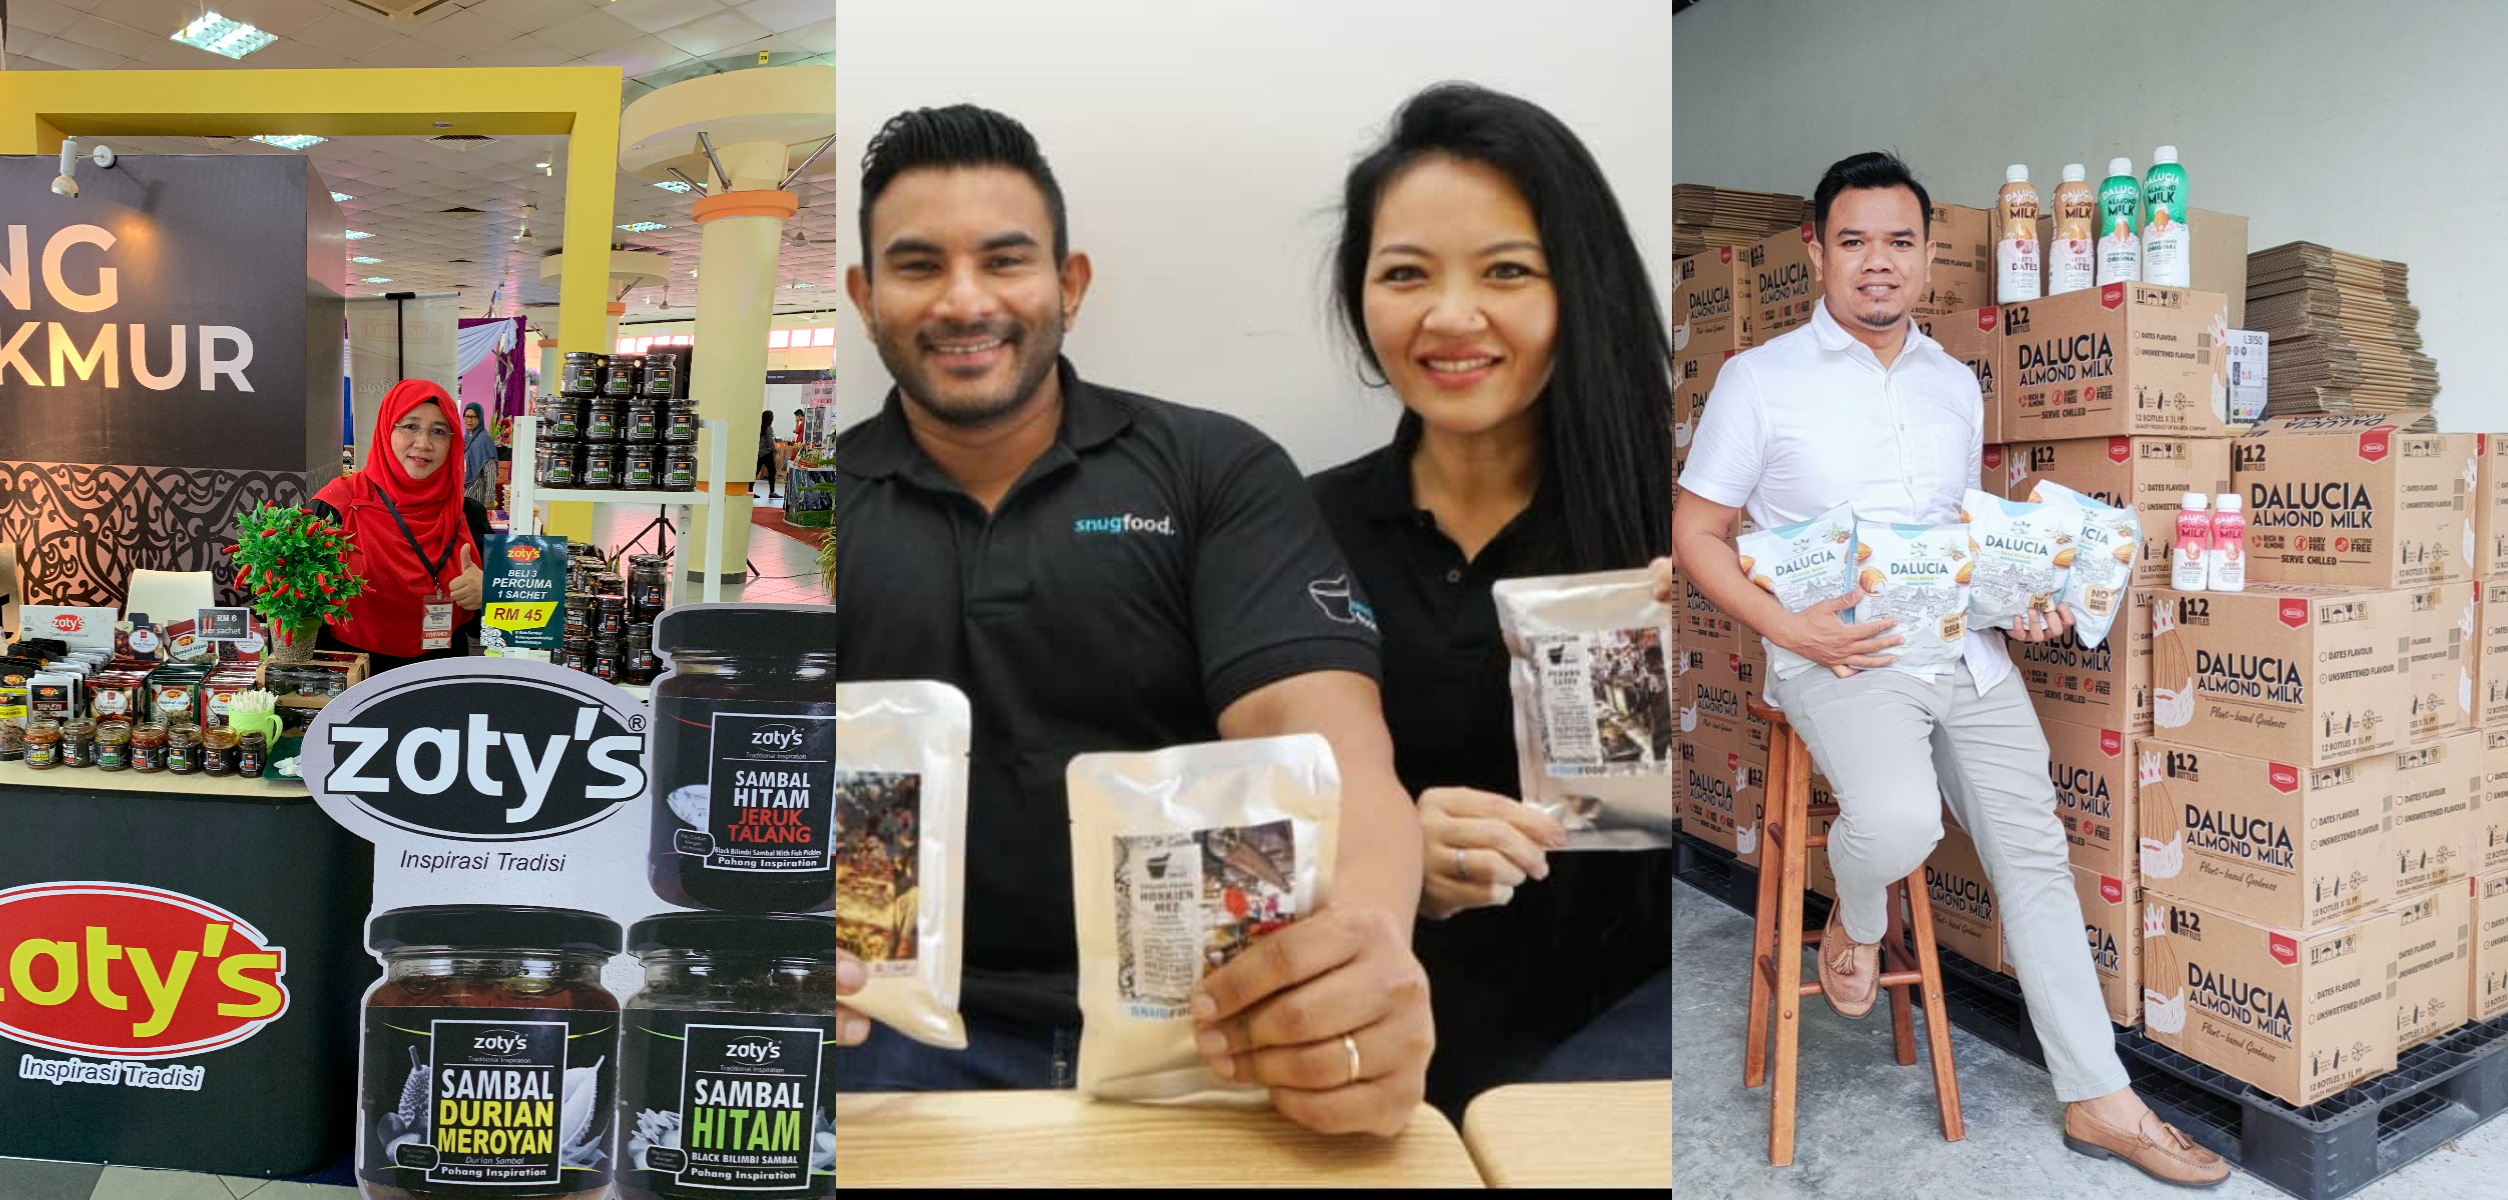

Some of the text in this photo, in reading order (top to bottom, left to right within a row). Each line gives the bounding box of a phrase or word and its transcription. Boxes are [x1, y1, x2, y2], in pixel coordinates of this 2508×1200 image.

[2147, 191, 2175, 206] MILK
[2009, 208, 2037, 219] MILK
[2065, 208, 2092, 219] MILK
[2108, 205, 2135, 217] MILK
[1685, 259, 1695, 273] 12
[2011, 263, 2038, 271] DATES
[1759, 261, 1809, 293] DALUCIA
[1689, 286, 1731, 310] DALUCIA
[1760, 281, 1810, 305] ALMOND MILK
[2012, 306, 2030, 326] 12
[2019, 332, 2114, 370] DALUCIA
[2019, 358, 2114, 387] ALMOND MILK
[2041, 407, 2086, 419] SERVE CHILLED
[2037, 446, 2055, 463] 12
[2244, 444, 2266, 462] 12
[2251, 482, 2372, 511] DALUCIA
[2252, 510, 2373, 529] ALMOND MILK
[2181, 529, 2206, 538] MILK
[2219, 530, 2243, 539] MILK
[507, 547, 541, 561] zaty's
[1985, 534, 2049, 556] DALUCIA
[2350, 544, 2372, 552] FREE
[1775, 549, 1836, 577] DALUCIA
[1890, 562, 1949, 575] DALUCIA
[2281, 555, 2337, 565] SERVE CHILLED
[508, 569, 530, 578] BELI
[492, 578, 552, 589] PERCUMA
[498, 590, 547, 599] 1 SACHET
[2091, 589, 2109, 599] NO
[493, 608, 543, 621] RM 45
[2187, 598, 2209, 617] 12
[216, 614, 229, 622] RM
[2187, 616, 2210, 626] BOTTLES
[202, 627, 242, 637] per sachet
[1693, 652, 1703, 664] 12
[2024, 646, 2112, 673] ALMOND MILK
[2328, 646, 2373, 660] DATES FLAVOUR
[1742, 663, 1753, 677] 12
[2196, 649, 2303, 687] DALUCIA
[2328, 664, 2395, 682] UNSWEETENED FLAVOUR
[1697, 683, 1739, 707] DALUCIA
[2197, 675, 2304, 705] ALMOND MILK
[2255, 712, 2287, 729] Goodness
[751, 728, 803, 750] zaty's
[327, 706, 645, 824] zaty's
[746, 751, 807, 761] Traditional Inspiration
[2176, 752, 2199, 772] 12
[735, 770, 811, 787] SAMBAL
[1689, 769, 1734, 801] DALUCIA
[2176, 771, 2199, 782] BOTTLES
[733, 788, 810, 808] HITAM
[738, 808, 803, 826] JERUK
[2080, 797, 2111, 819] MILK
[2336, 808, 2360, 822] FLAVOUR
[728, 825, 811, 843] TALANG
[2185, 804, 2294, 852] DALUCIA
[2318, 830, 2357, 847] UNSWEETENED
[715, 846, 730, 854] Black
[731, 848, 752, 856] Bilimbi
[2186, 830, 2294, 869] ALMOND MILK
[400, 850, 566, 872] Inspirasi Tradisi
[718, 857, 818, 869] Pahang Inspiration
[1925, 865, 1992, 908] DALUCIA
[2178, 910, 2201, 932] 12
[0, 923, 282, 1037] aty's
[2188, 961, 2292, 1026] DALUCIA
[2189, 989, 2293, 1043] ALMOND MILK
[2316, 1002, 2358, 1021] UNSWEETENED
[473, 1034, 527, 1054] zaty's
[725, 1041, 781, 1063] zaty's
[468, 1056, 531, 1065] Traditional Inspiration
[720, 1064, 785, 1074] Traditional Inspiration
[23, 1058, 201, 1087] Inspirasi Tradisi
[441, 1069, 554, 1100] SAMBAL
[694, 1079, 804, 1108] SAMBAL
[439, 1099, 554, 1128] DURIAN
[692, 1107, 800, 1151] HITAM
[438, 1128, 552, 1154] MEROYAN
[465, 1156, 525, 1165] Durian Sambal
[691, 1152, 798, 1164] BLACK BILIMBI SAMBAL
[441, 1166, 547, 1179] Pahang Inspiration
[691, 1168, 796, 1182] Pahang Inspiration
